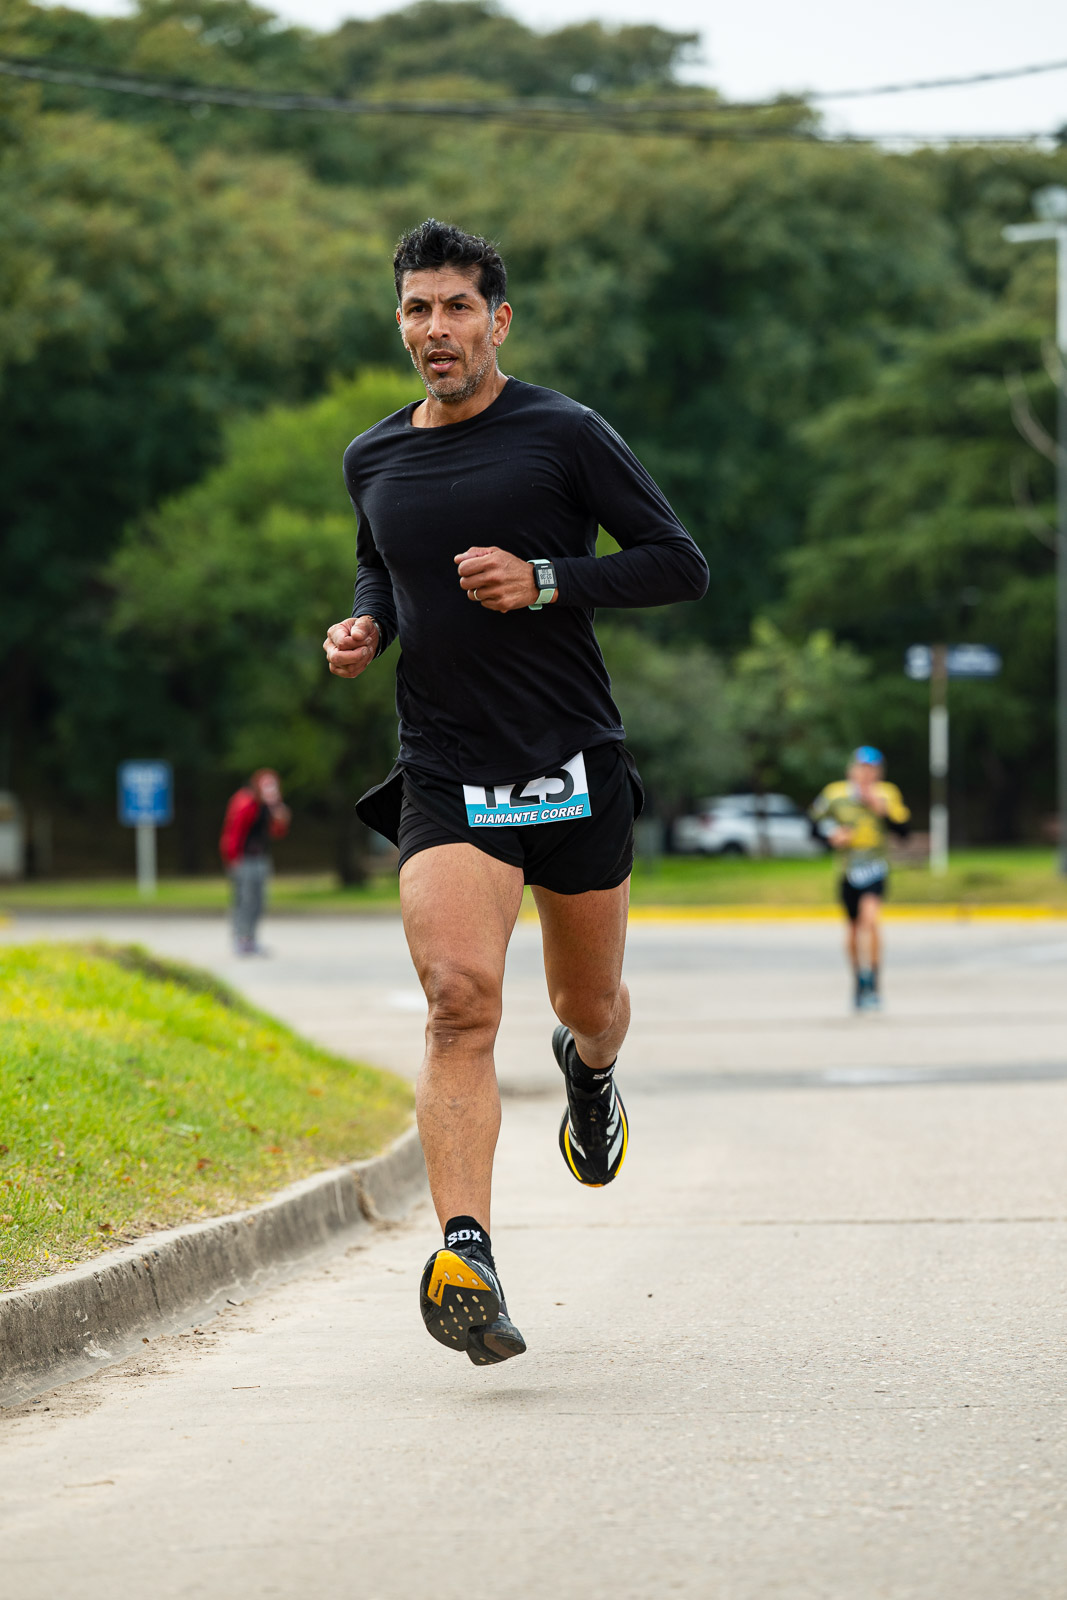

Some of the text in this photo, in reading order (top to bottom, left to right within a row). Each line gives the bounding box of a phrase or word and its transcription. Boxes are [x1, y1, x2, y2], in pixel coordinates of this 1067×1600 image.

[473, 804, 584, 824] DIAMANTE CORRE
[447, 1229, 482, 1247] SOX
